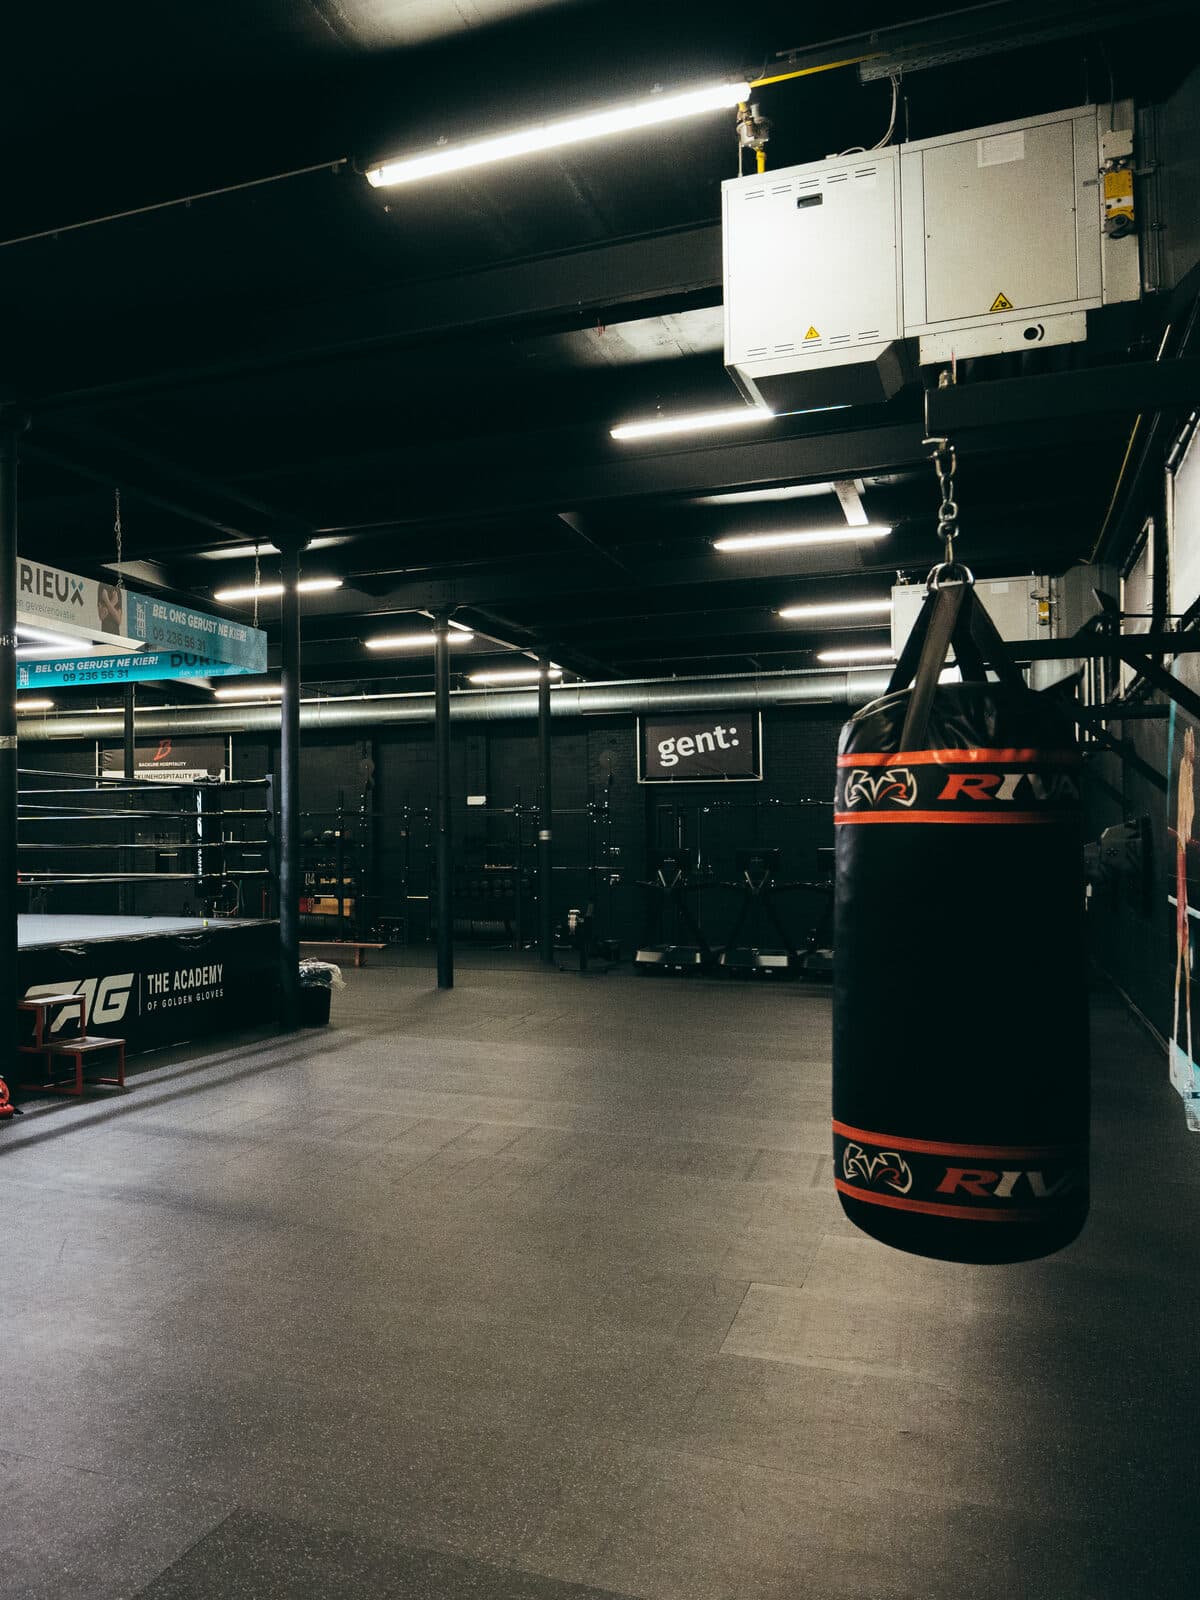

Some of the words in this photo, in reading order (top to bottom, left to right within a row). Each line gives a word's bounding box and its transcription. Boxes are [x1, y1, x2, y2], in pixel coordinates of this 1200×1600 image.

[152, 603, 168, 619] BEL
[169, 610, 186, 626] ONS
[188, 614, 218, 634] GERUST
[217, 624, 228, 637] NE
[152, 626, 164, 641] 09
[35, 664, 52, 673] BEL
[54, 662, 74, 673] ONS
[76, 659, 114, 670] GERUST
[116, 658, 131, 667] NE
[132, 655, 159, 666] KIER!
[63, 673, 76, 682] 09
[79, 671, 98, 681] 236
[101, 670, 114, 680] 56
[117, 669, 129, 679] 31
[657, 725, 740, 767] gent:
[147, 972, 169, 995] THE
[174, 963, 223, 991] ACADEMY
[147, 1001, 158, 1011] OF
[162, 995, 193, 1009] GOLDEN
[196, 988, 224, 1002] GLOVES
